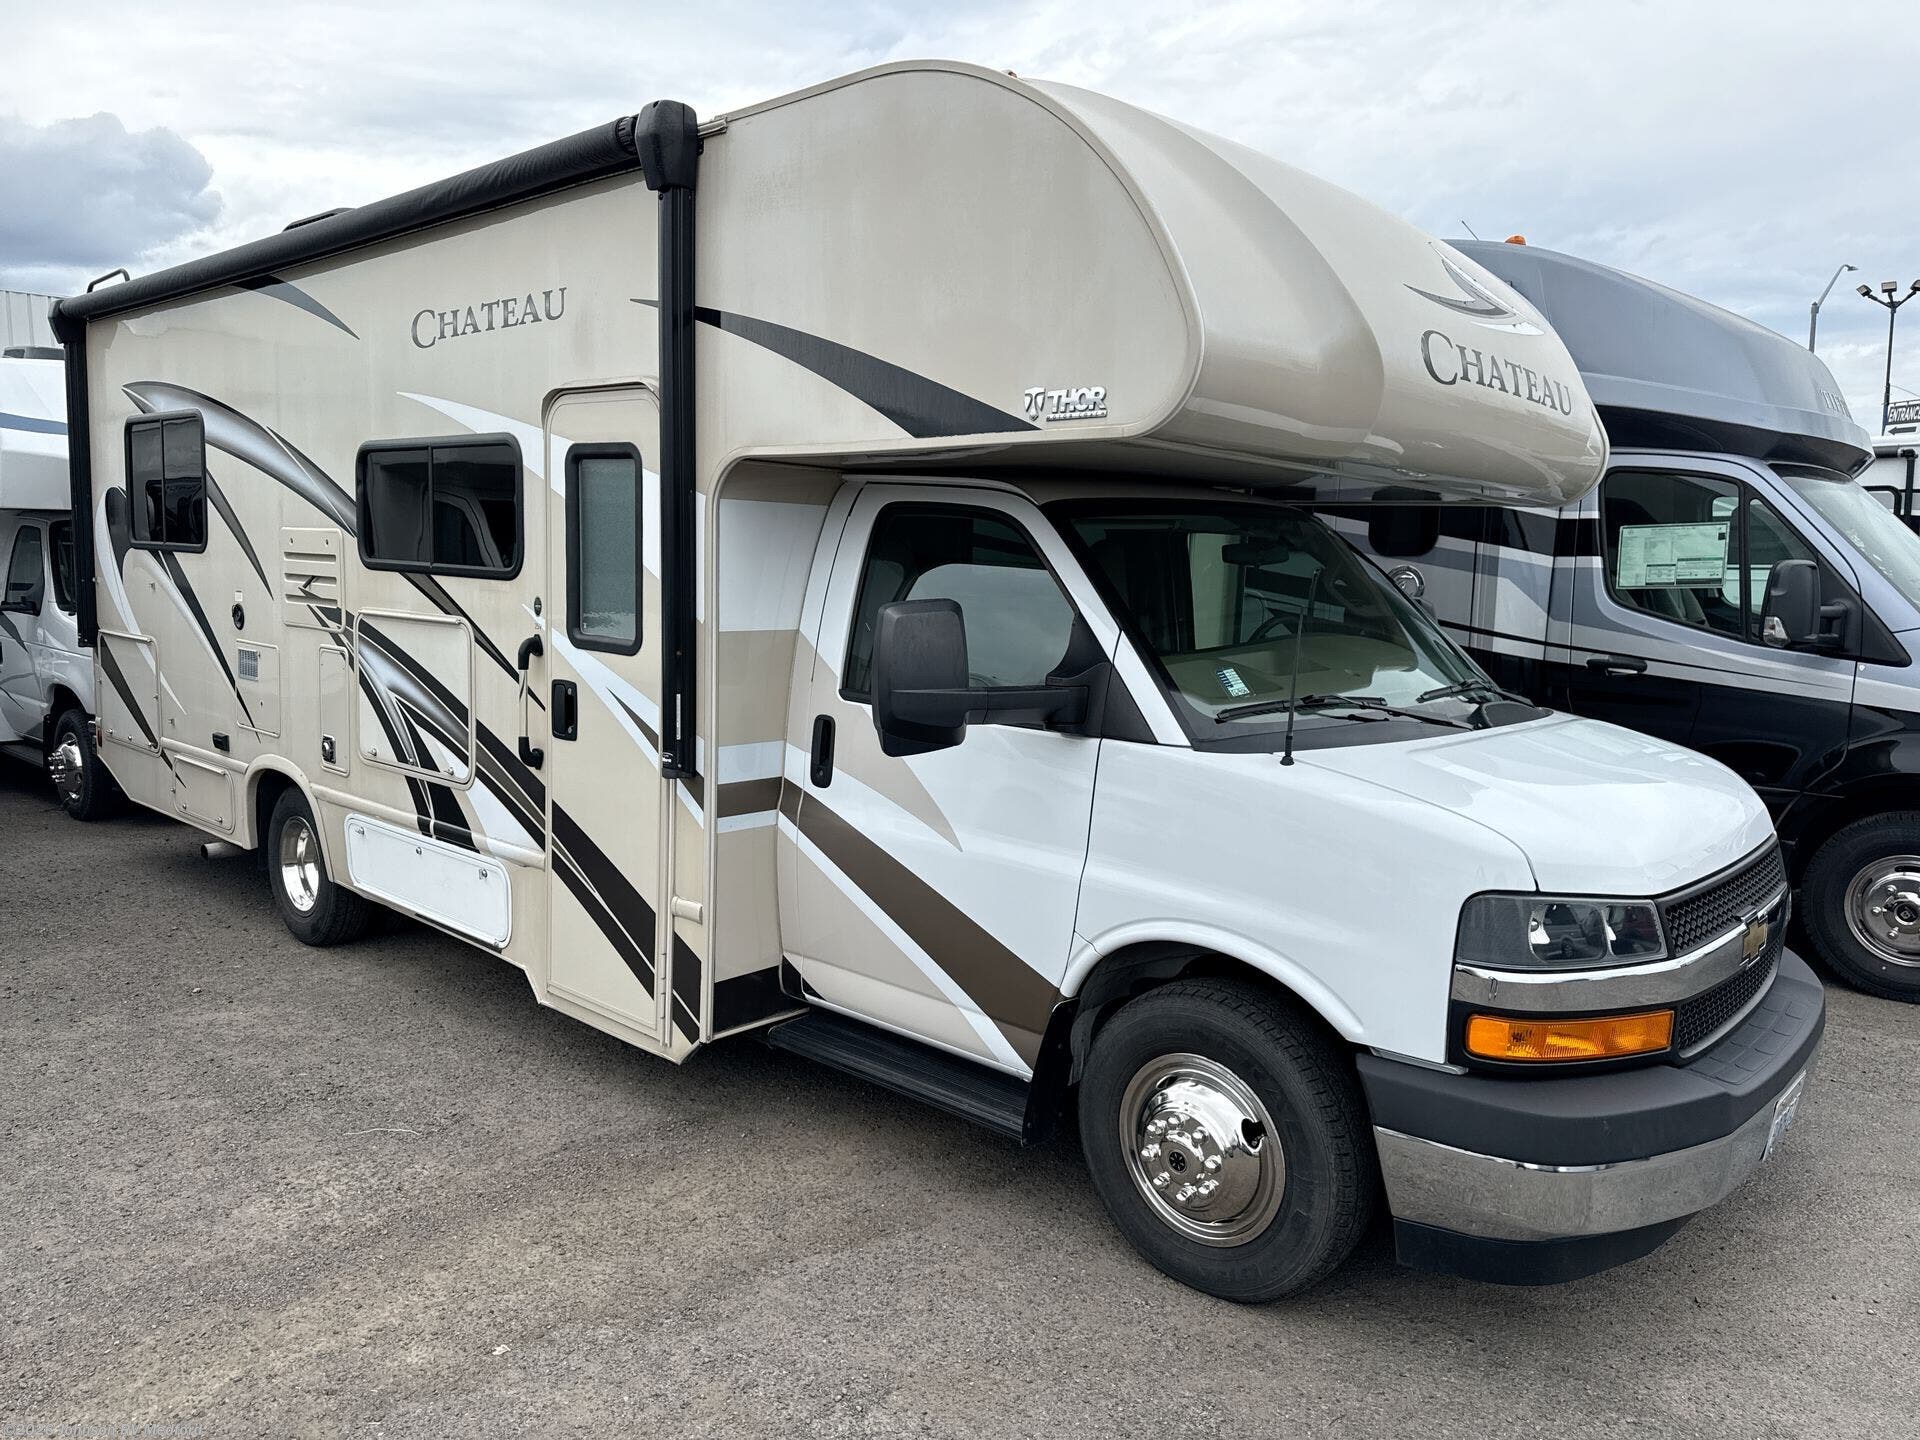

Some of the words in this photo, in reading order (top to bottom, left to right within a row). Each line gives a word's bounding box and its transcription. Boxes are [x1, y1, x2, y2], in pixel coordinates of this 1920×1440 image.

[411, 287, 567, 349] CHATEAU
[1047, 386, 1107, 414] THOR
[1421, 330, 1572, 416] CHATEAU
